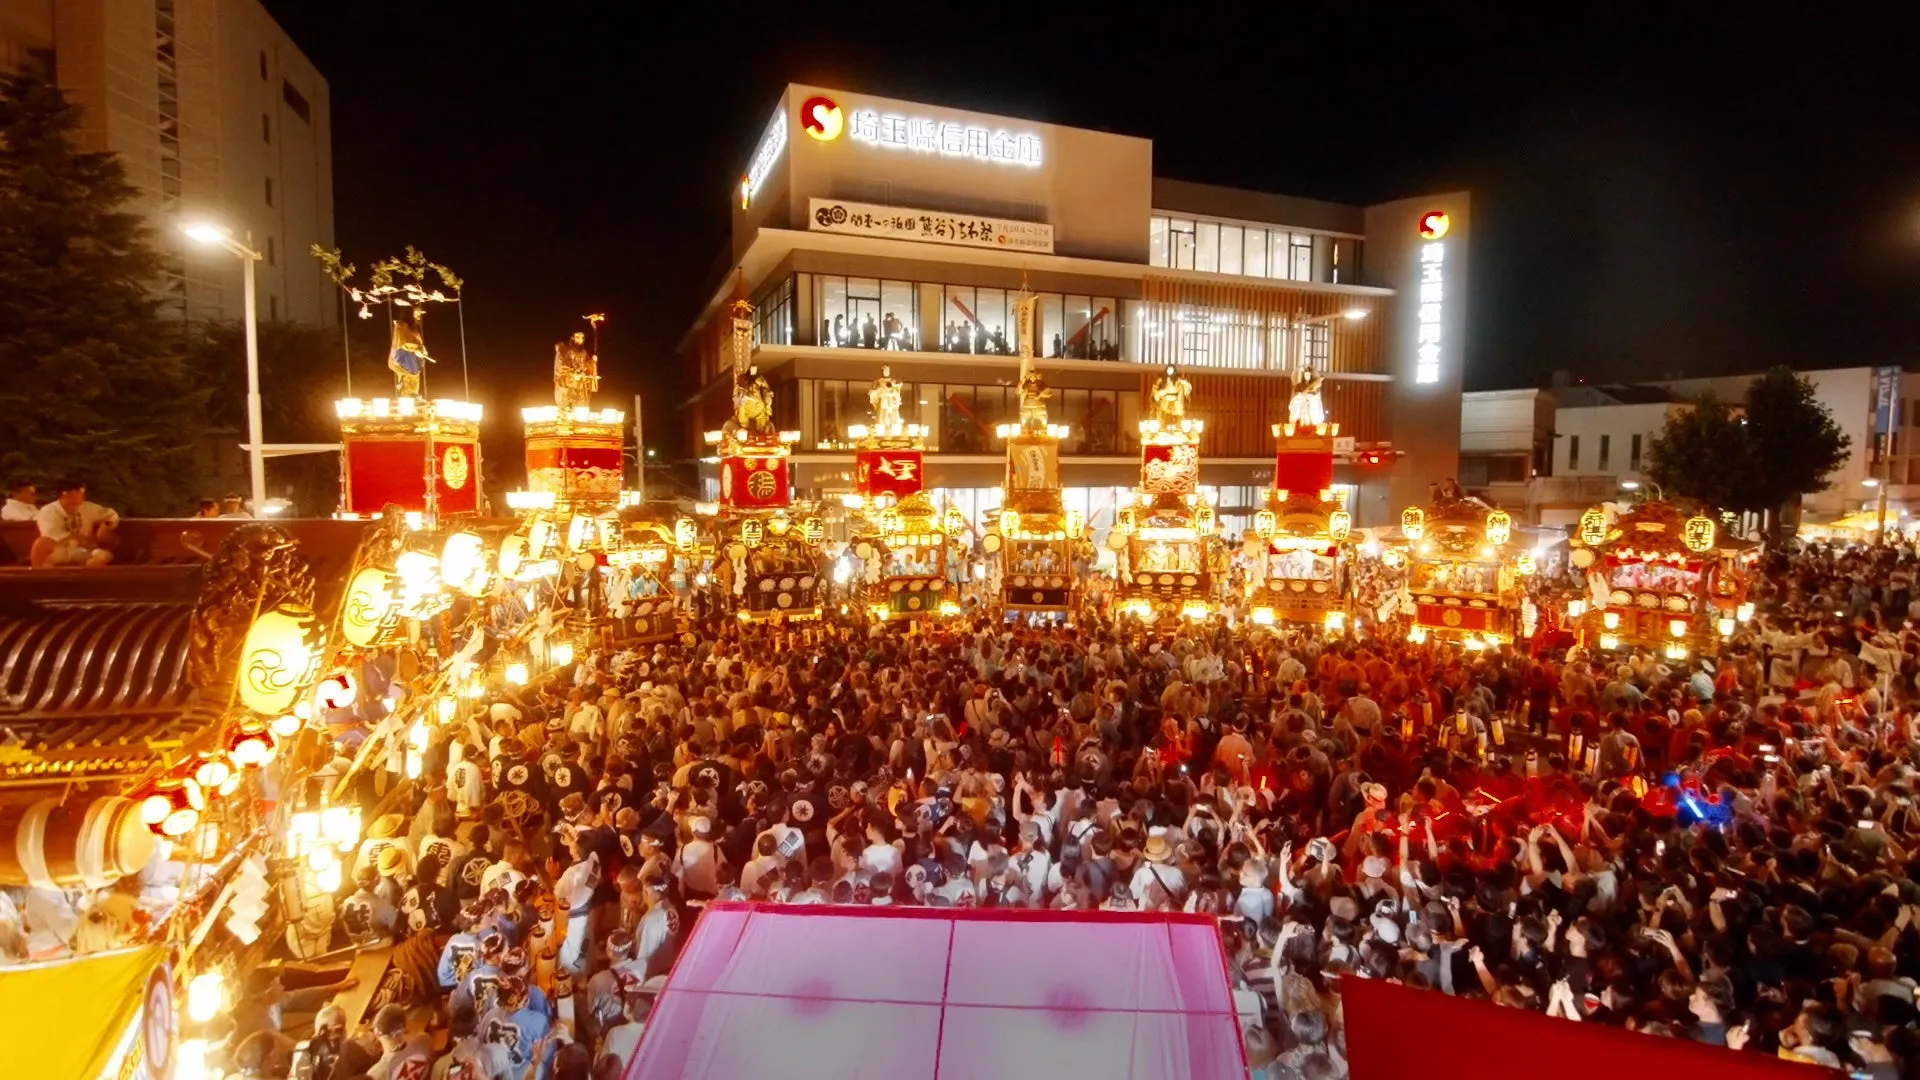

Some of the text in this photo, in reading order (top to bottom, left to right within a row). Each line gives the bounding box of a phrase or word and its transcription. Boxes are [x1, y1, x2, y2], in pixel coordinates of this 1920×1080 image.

[919, 216, 993, 242] 熊谷うちわ祭
